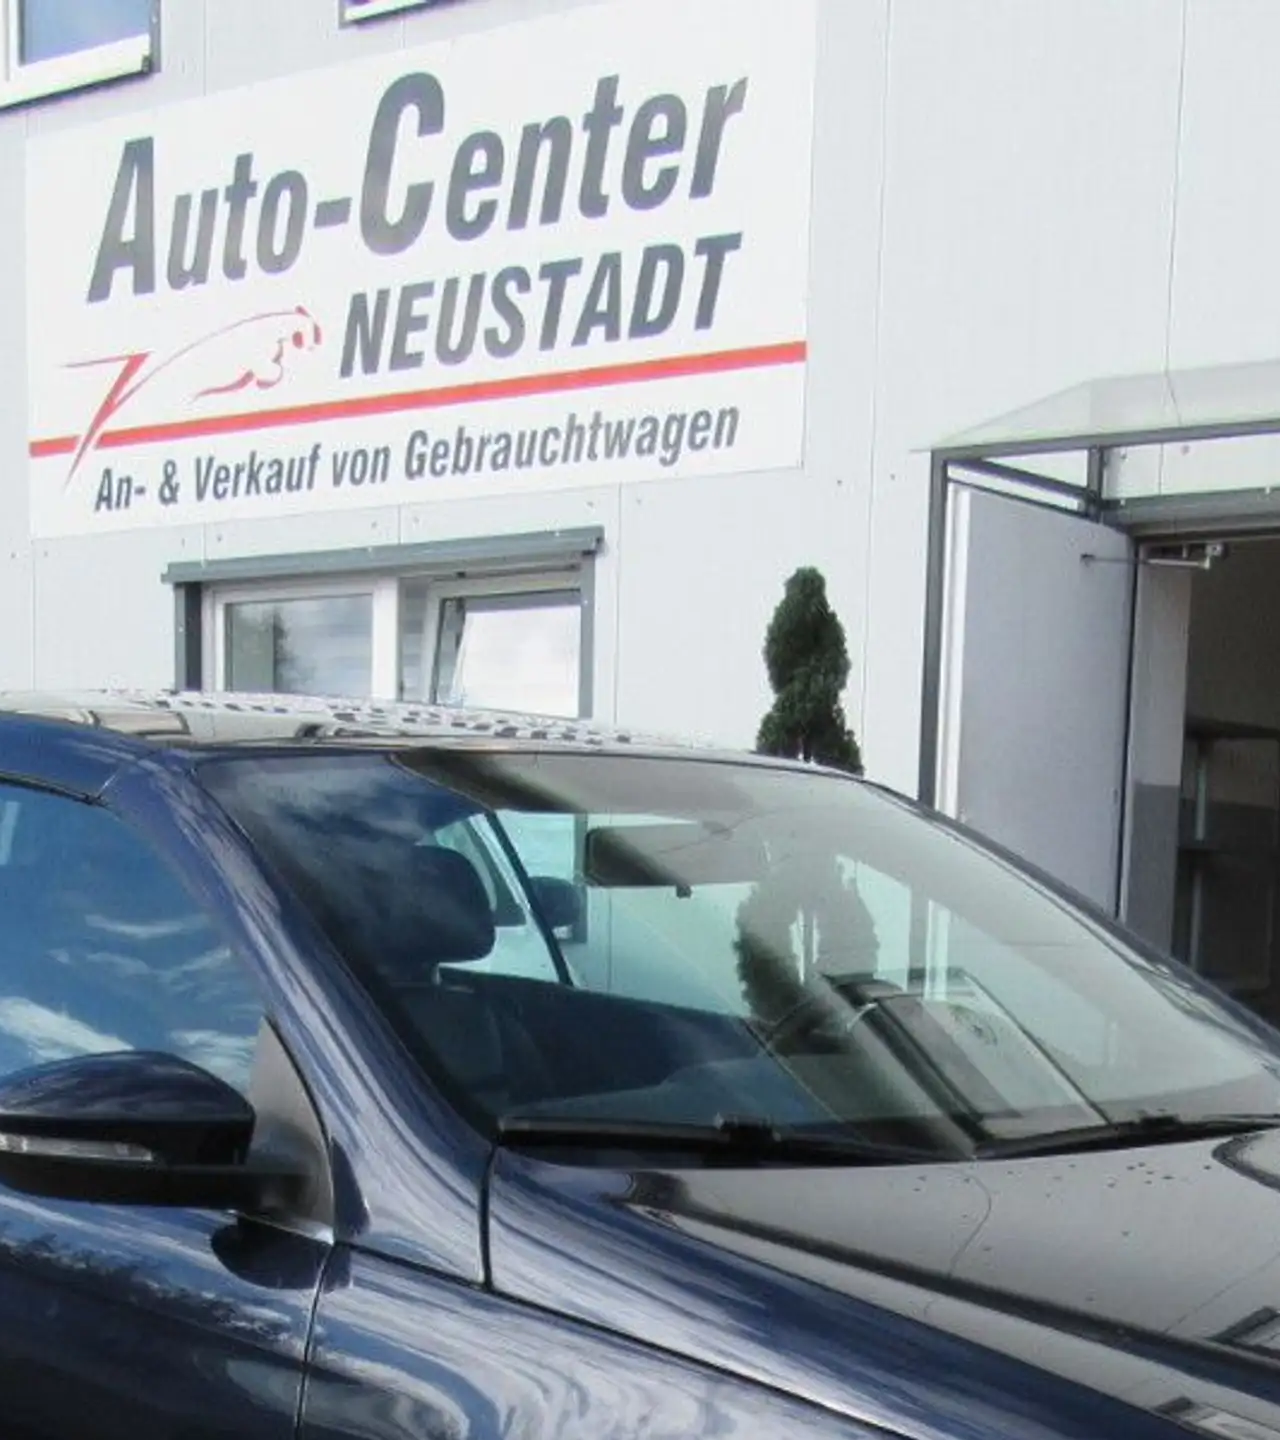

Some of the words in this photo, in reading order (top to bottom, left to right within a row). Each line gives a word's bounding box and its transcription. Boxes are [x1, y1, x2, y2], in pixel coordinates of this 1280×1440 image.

[86, 70, 749, 303] Auto-Center
[338, 231, 742, 379] NEUSTADT
[94, 467, 146, 512] An-
[158, 459, 180, 506] &
[194, 442, 322, 502] Verkauf
[332, 444, 391, 488] von
[404, 405, 740, 481] Gebrauchtwagen
